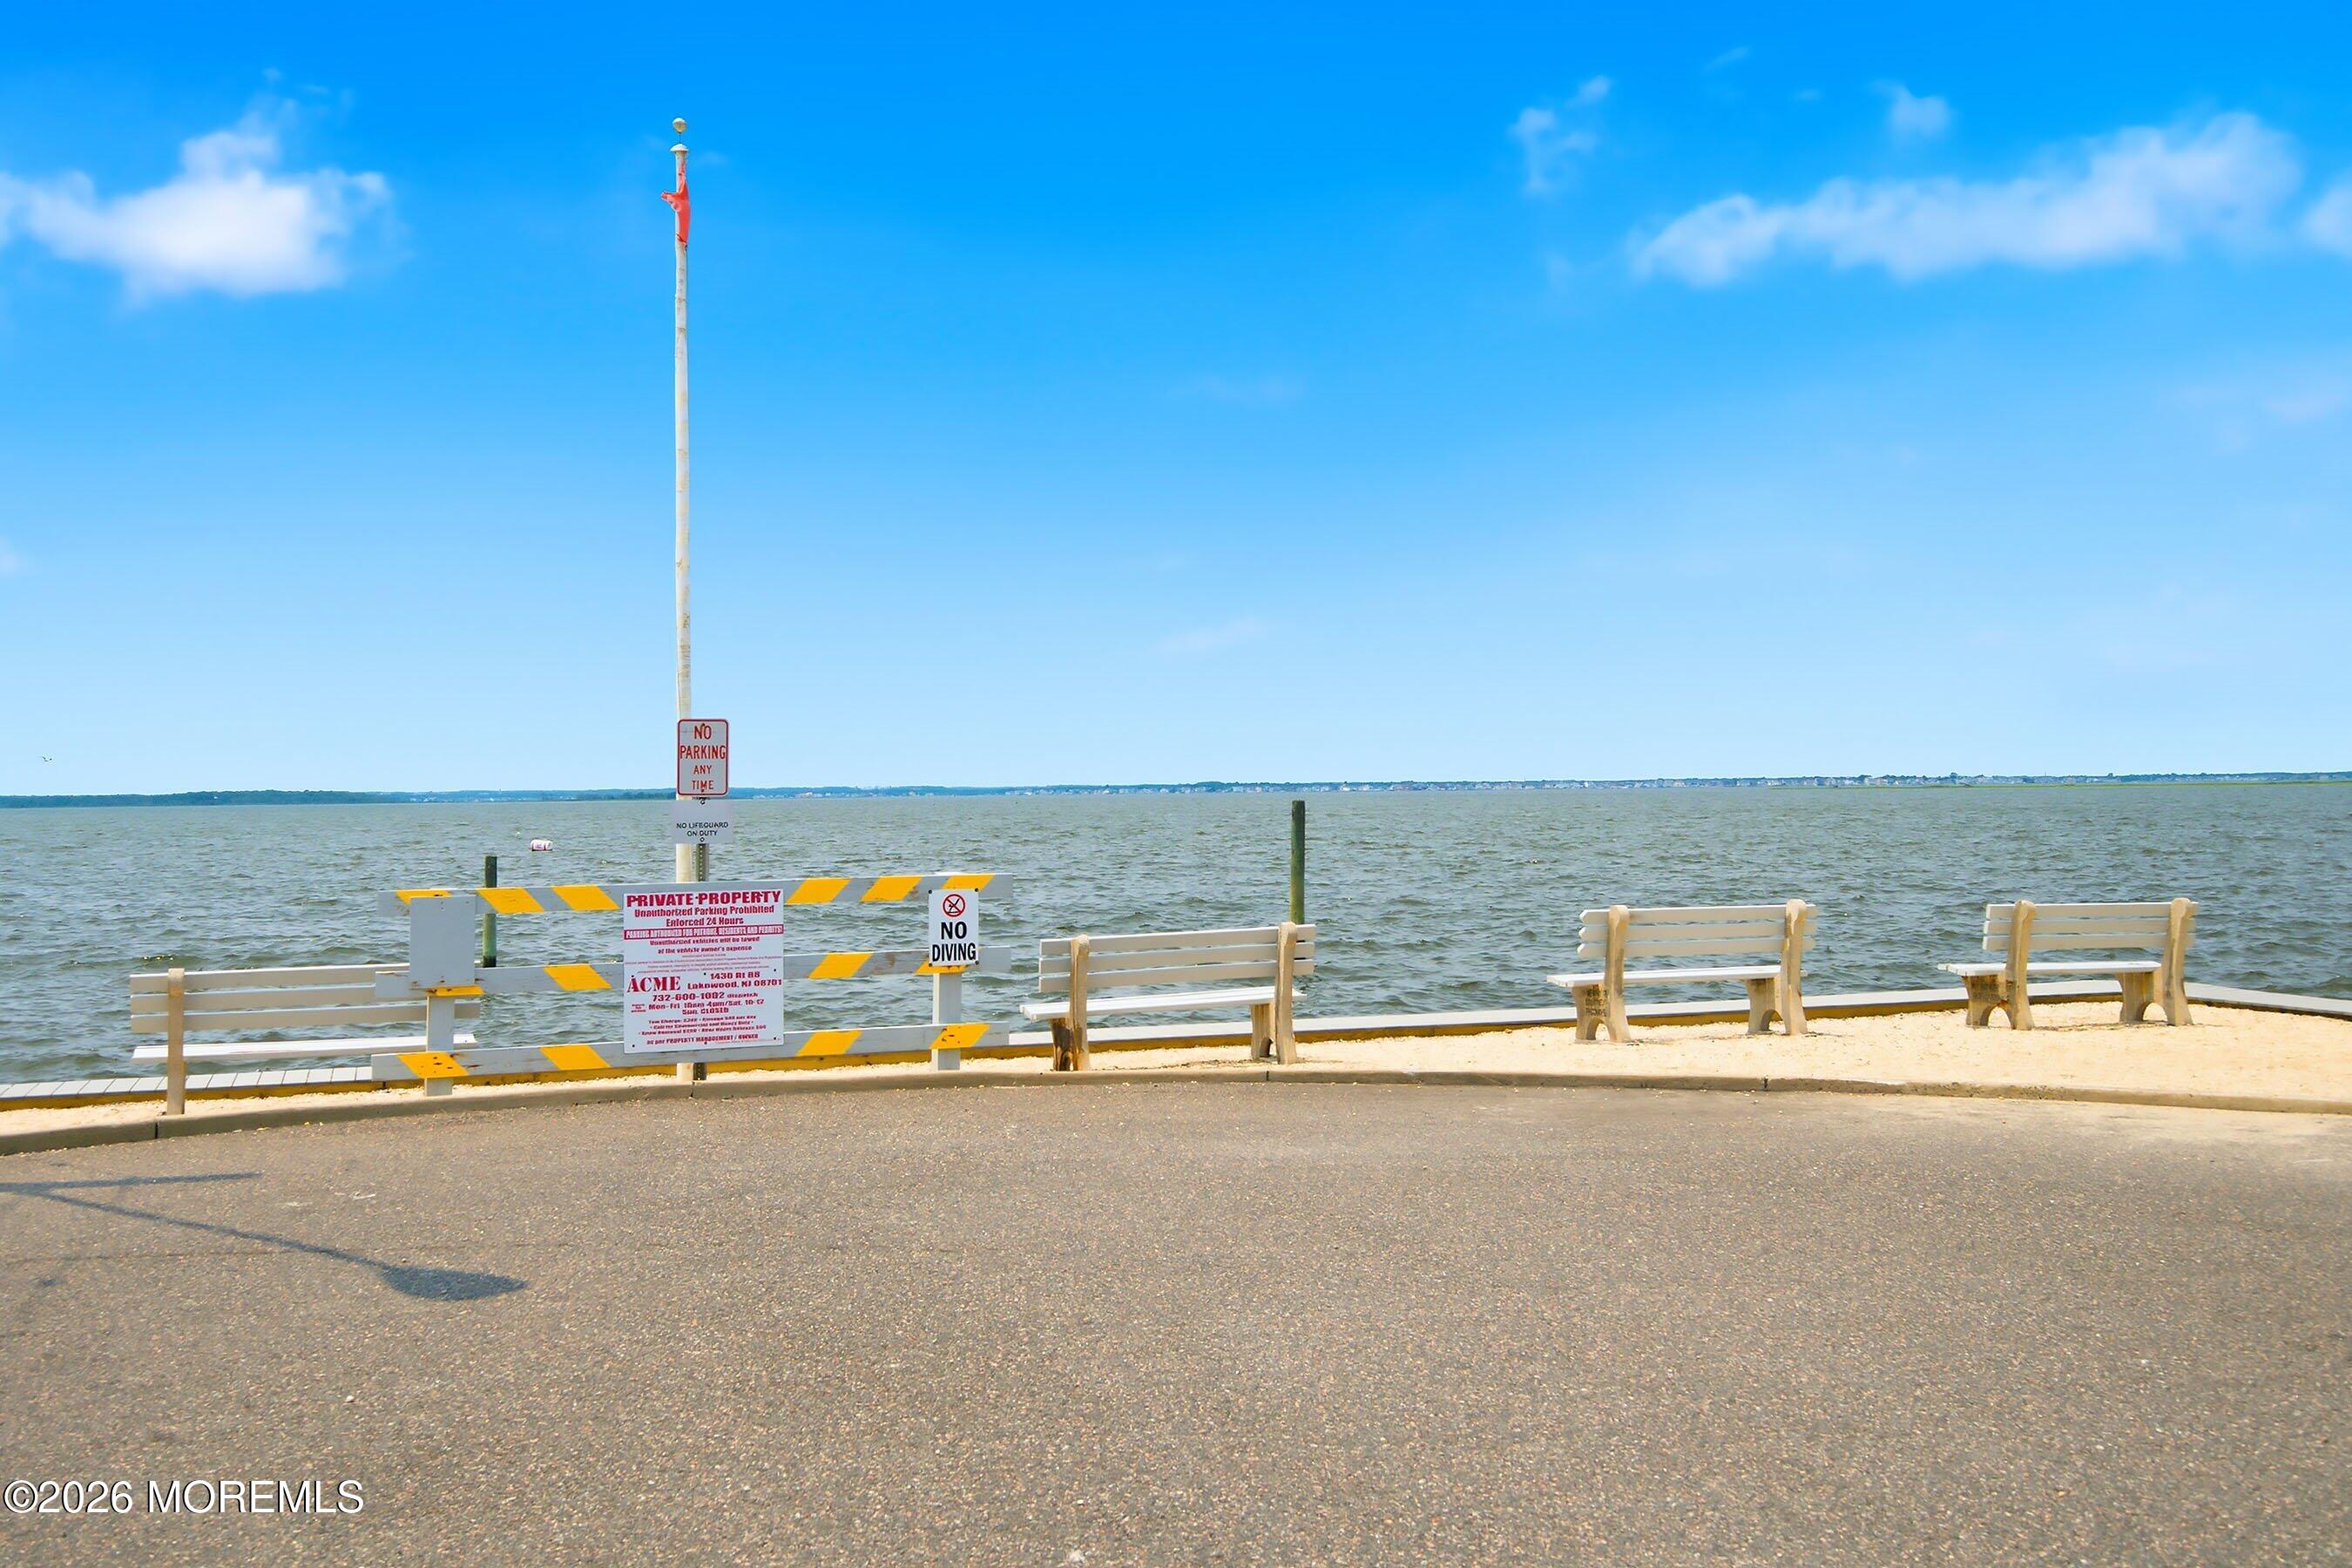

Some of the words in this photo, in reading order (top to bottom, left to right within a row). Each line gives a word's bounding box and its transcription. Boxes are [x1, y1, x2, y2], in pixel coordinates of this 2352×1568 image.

[694, 725, 712, 740] NO
[679, 745, 726, 760] PARKING
[693, 765, 713, 774] ANY
[692, 781, 714, 790] TIME
[626, 893, 694, 908] PRIVATE
[698, 890, 781, 905] PROPERTY
[634, 907, 693, 917] Unauthorized
[694, 907, 727, 916] Parking
[730, 905, 774, 915] Prohibited
[666, 918, 705, 927] Enforced
[719, 916, 744, 925] Hours
[941, 921, 967, 940] NO
[931, 943, 976, 962] DIVING
[627, 976, 681, 992] ACME
[687, 981, 739, 990] Lakewood,
